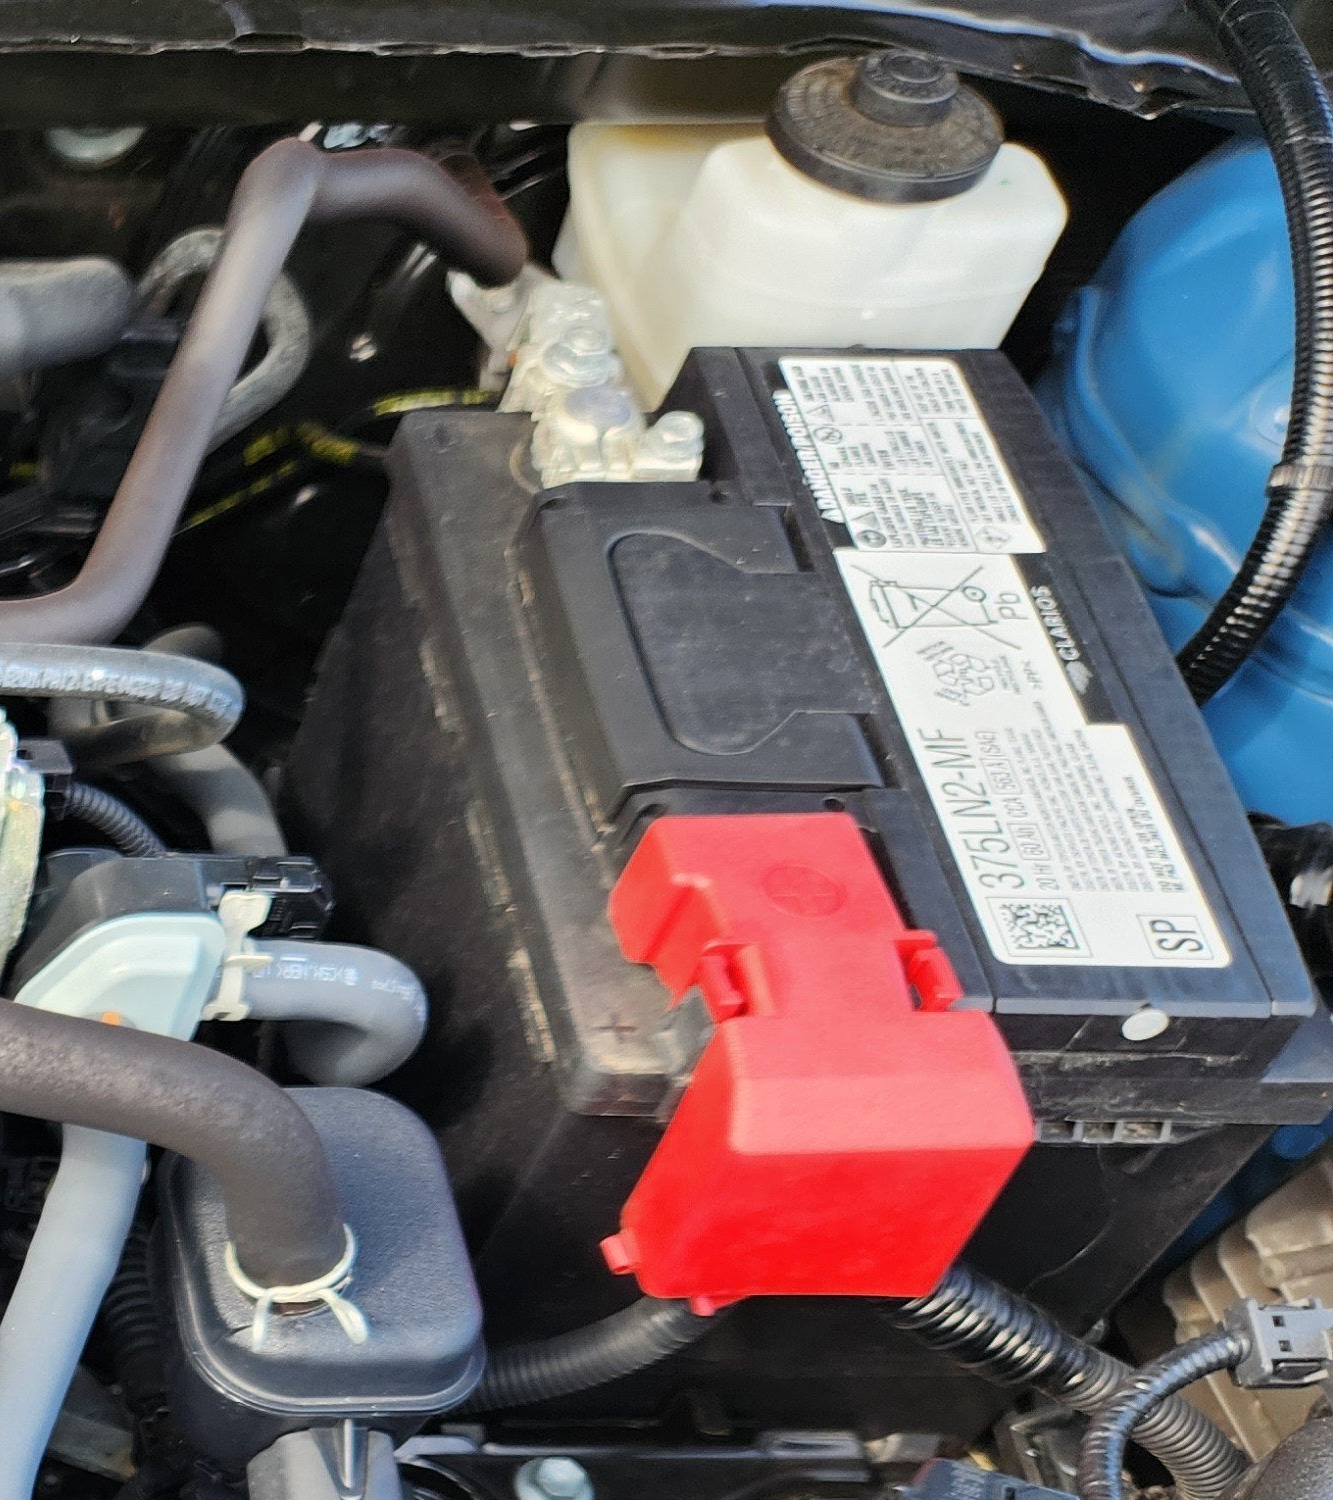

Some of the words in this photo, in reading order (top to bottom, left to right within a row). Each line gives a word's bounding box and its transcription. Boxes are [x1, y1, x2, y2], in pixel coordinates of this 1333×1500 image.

[995, 592, 1028, 619] Pb
[1028, 585, 1081, 660] CLARIOS
[915, 728, 1028, 888] 375LN2-MF
[1150, 918, 1204, 953] SP
